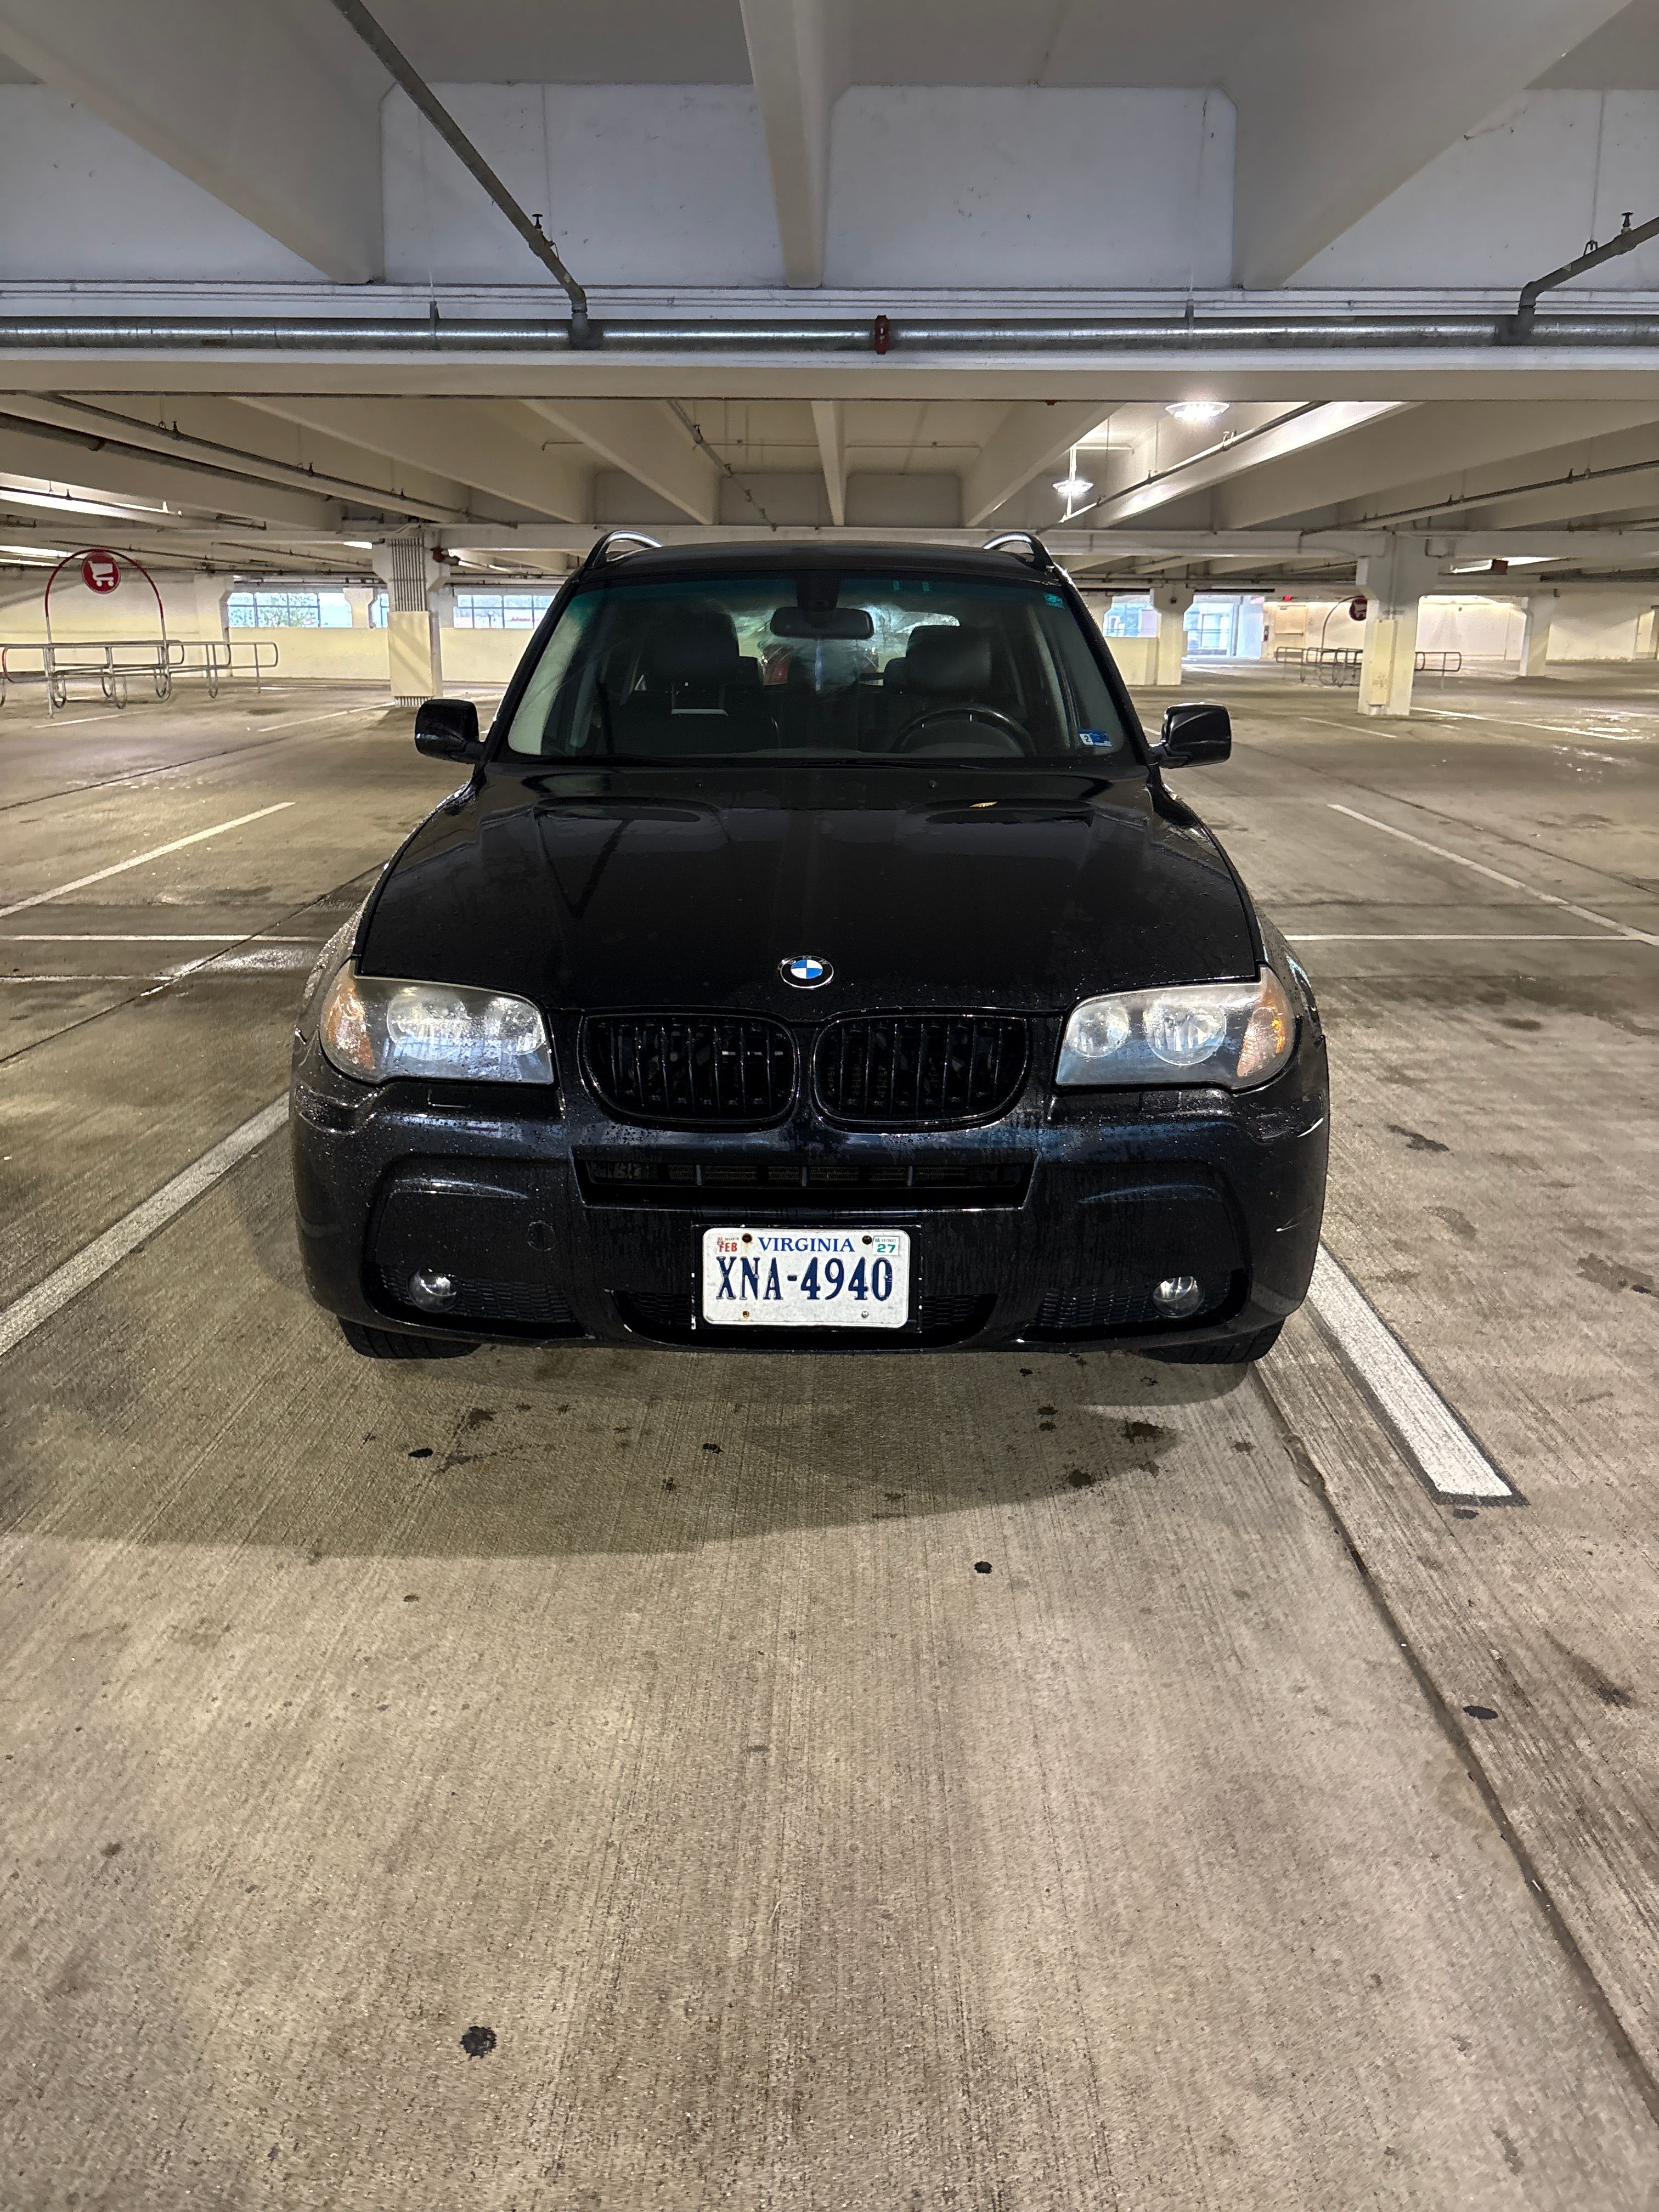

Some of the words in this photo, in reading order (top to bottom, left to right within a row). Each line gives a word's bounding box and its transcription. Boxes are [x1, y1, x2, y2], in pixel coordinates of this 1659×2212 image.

[787, 955, 829, 965] BMW
[718, 1242, 737, 1252] FEB
[758, 1237, 855, 1252] VIRGINIA
[877, 1244, 896, 1253] 27
[716, 1256, 893, 1301] XNA-4940
